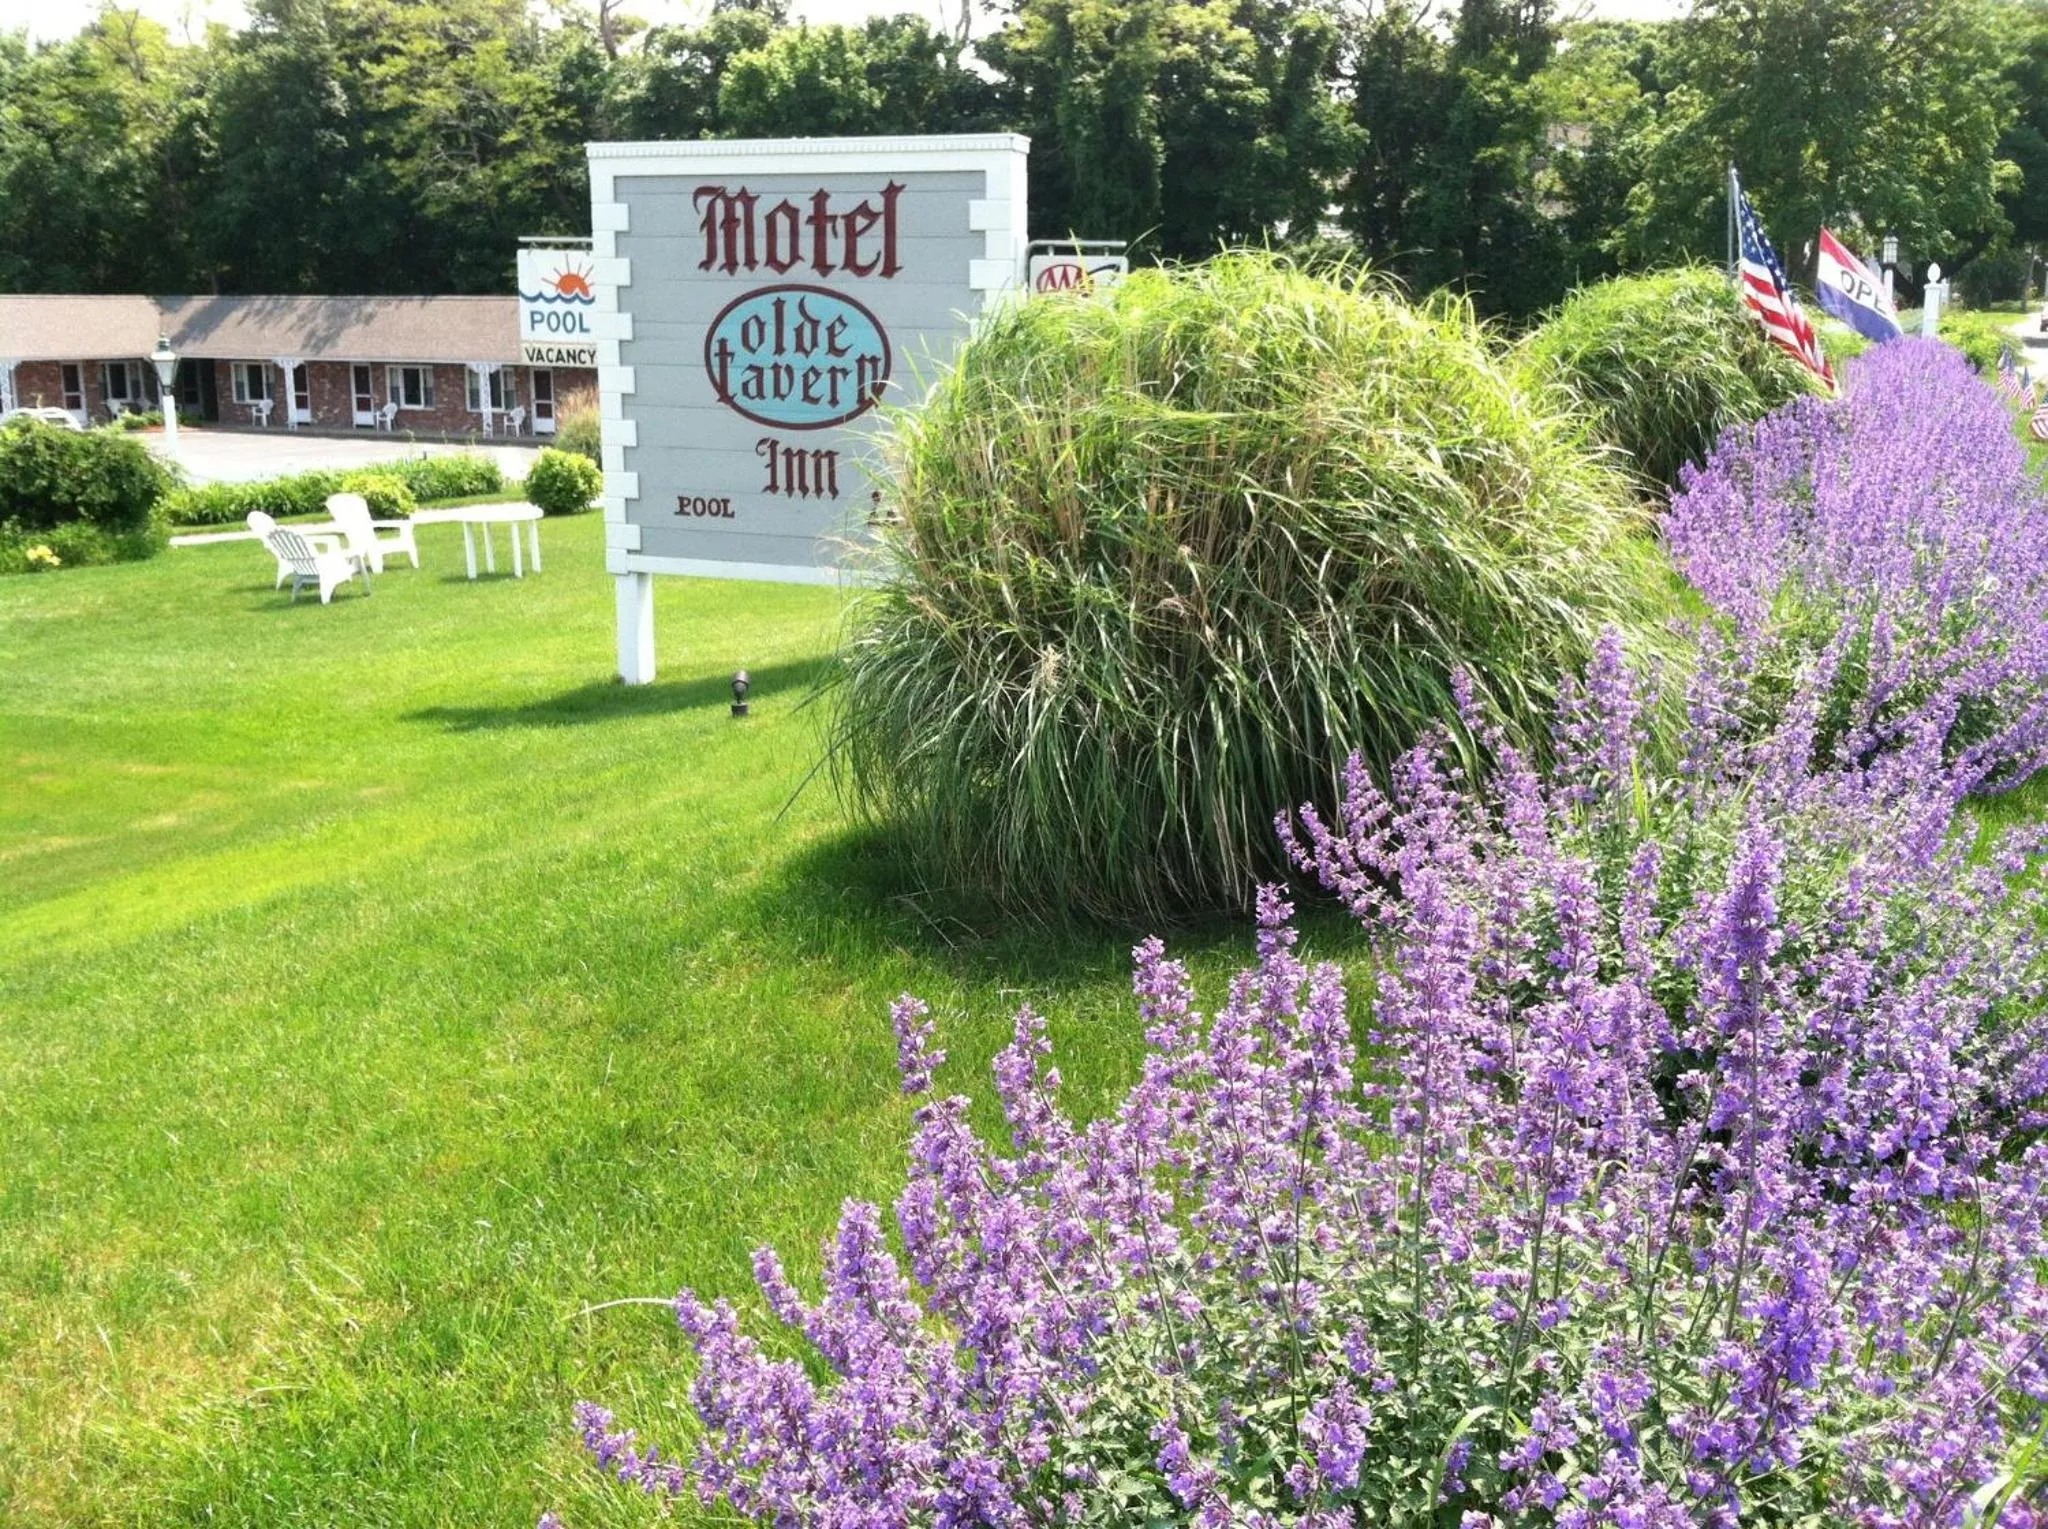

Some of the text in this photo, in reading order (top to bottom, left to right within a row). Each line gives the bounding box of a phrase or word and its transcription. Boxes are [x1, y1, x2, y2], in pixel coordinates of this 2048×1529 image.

[692, 179, 907, 279] Motel
[530, 310, 591, 334] POOL
[741, 295, 853, 358] olde
[525, 347, 597, 365] VACANCY
[714, 338, 881, 409] tavern
[755, 436, 840, 500] Inn
[674, 495, 735, 518] POOL
